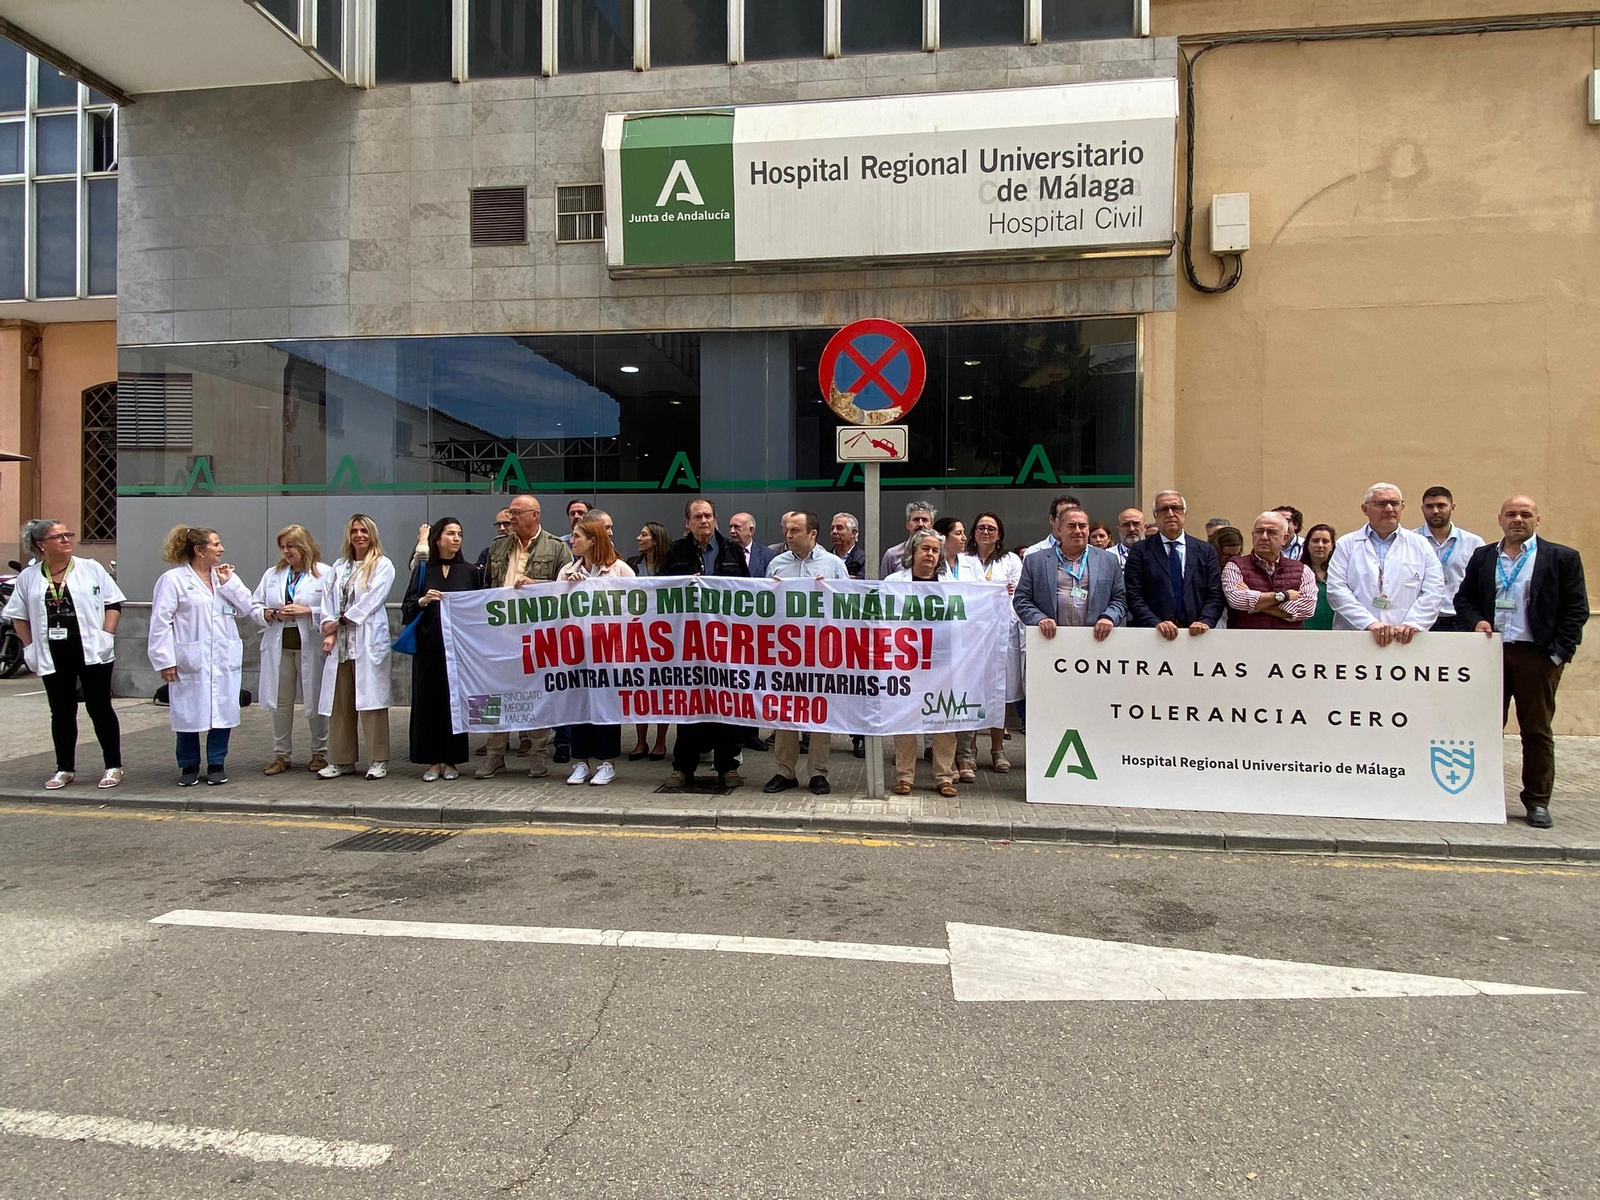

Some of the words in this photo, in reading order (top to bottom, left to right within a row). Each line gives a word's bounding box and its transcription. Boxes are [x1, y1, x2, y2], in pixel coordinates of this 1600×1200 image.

[750, 156, 849, 190] Hospital
[861, 149, 968, 184] Regional
[979, 140, 1144, 173] Universitario
[996, 177, 1028, 202] de
[1039, 173, 1135, 202] Málaga
[628, 212, 659, 223] Junta
[661, 211, 675, 222] de
[676, 208, 731, 222] Andalucía
[988, 208, 1084, 238] Hospital
[1095, 205, 1143, 230] Civil
[486, 589, 648, 626] SINDICATO
[656, 582, 776, 618] MÉDICO
[785, 590, 825, 618] DE
[832, 589, 967, 621] MÁLAGA
[522, 624, 585, 675] ¡NO
[591, 617, 675, 664] MÁS
[682, 620, 933, 671] AGRESIONES!
[544, 668, 609, 692] CONTRA
[613, 667, 645, 687] LAS
[649, 666, 750, 690] AGRESIONES
[754, 670, 766, 691] A
[771, 672, 911, 697] SANITARIAS-OS
[1054, 658, 1174, 677] CONTRA
[1193, 661, 1248, 678] LAS
[1267, 663, 1471, 683] AGRESIONES
[503, 690, 543, 703] SINDICATO
[504, 702, 534, 713] MÉDICO
[618, 688, 755, 720] TOLERANCIA
[762, 693, 828, 724] CERO
[505, 713, 536, 724] MÁLAGA
[1110, 703, 1307, 724] TOLERANCIA
[1327, 710, 1408, 728] CERO
[1122, 754, 1176, 768] Hospital
[1180, 756, 1239, 771] Regional
[1242, 758, 1332, 774] Universitario
[1335, 762, 1352, 774] de
[1356, 762, 1406, 779] Málaga
